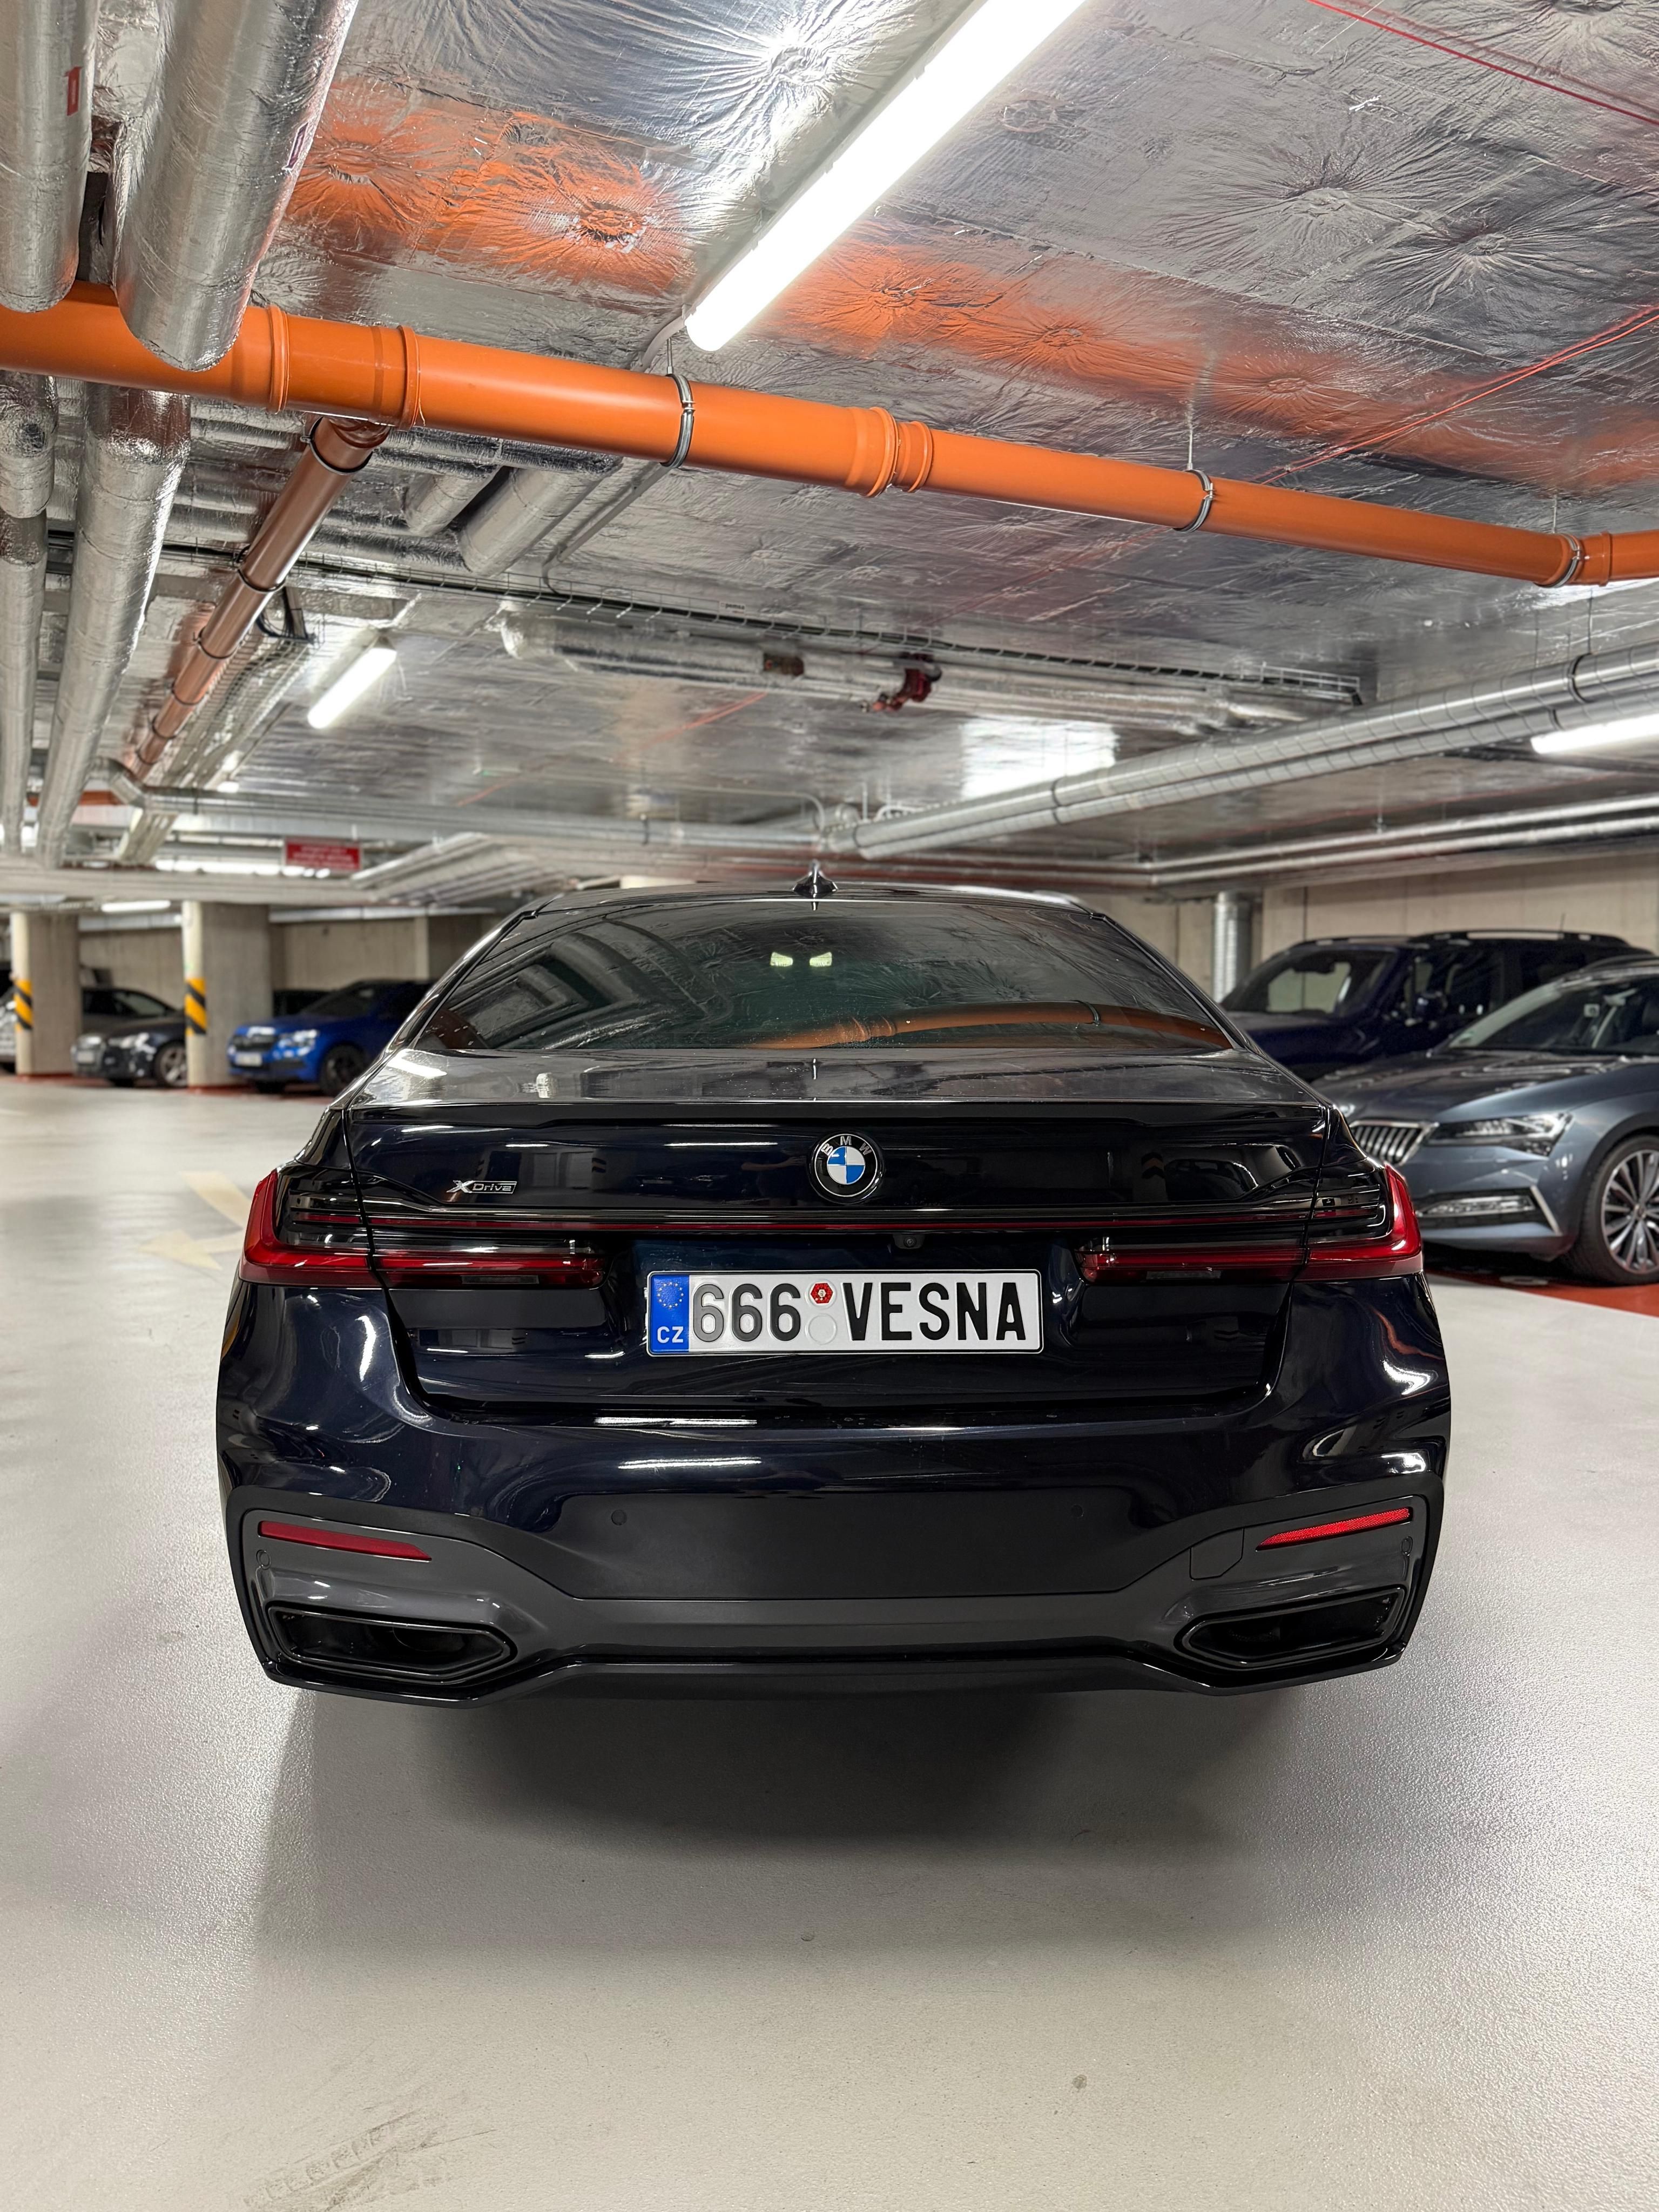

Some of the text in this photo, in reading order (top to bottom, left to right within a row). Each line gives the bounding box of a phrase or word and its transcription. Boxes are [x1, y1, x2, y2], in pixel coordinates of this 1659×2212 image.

[820, 1136, 872, 1156] BMW
[692, 1282, 1026, 1342] 666 VESNA
[657, 1326, 684, 1343] CZ
